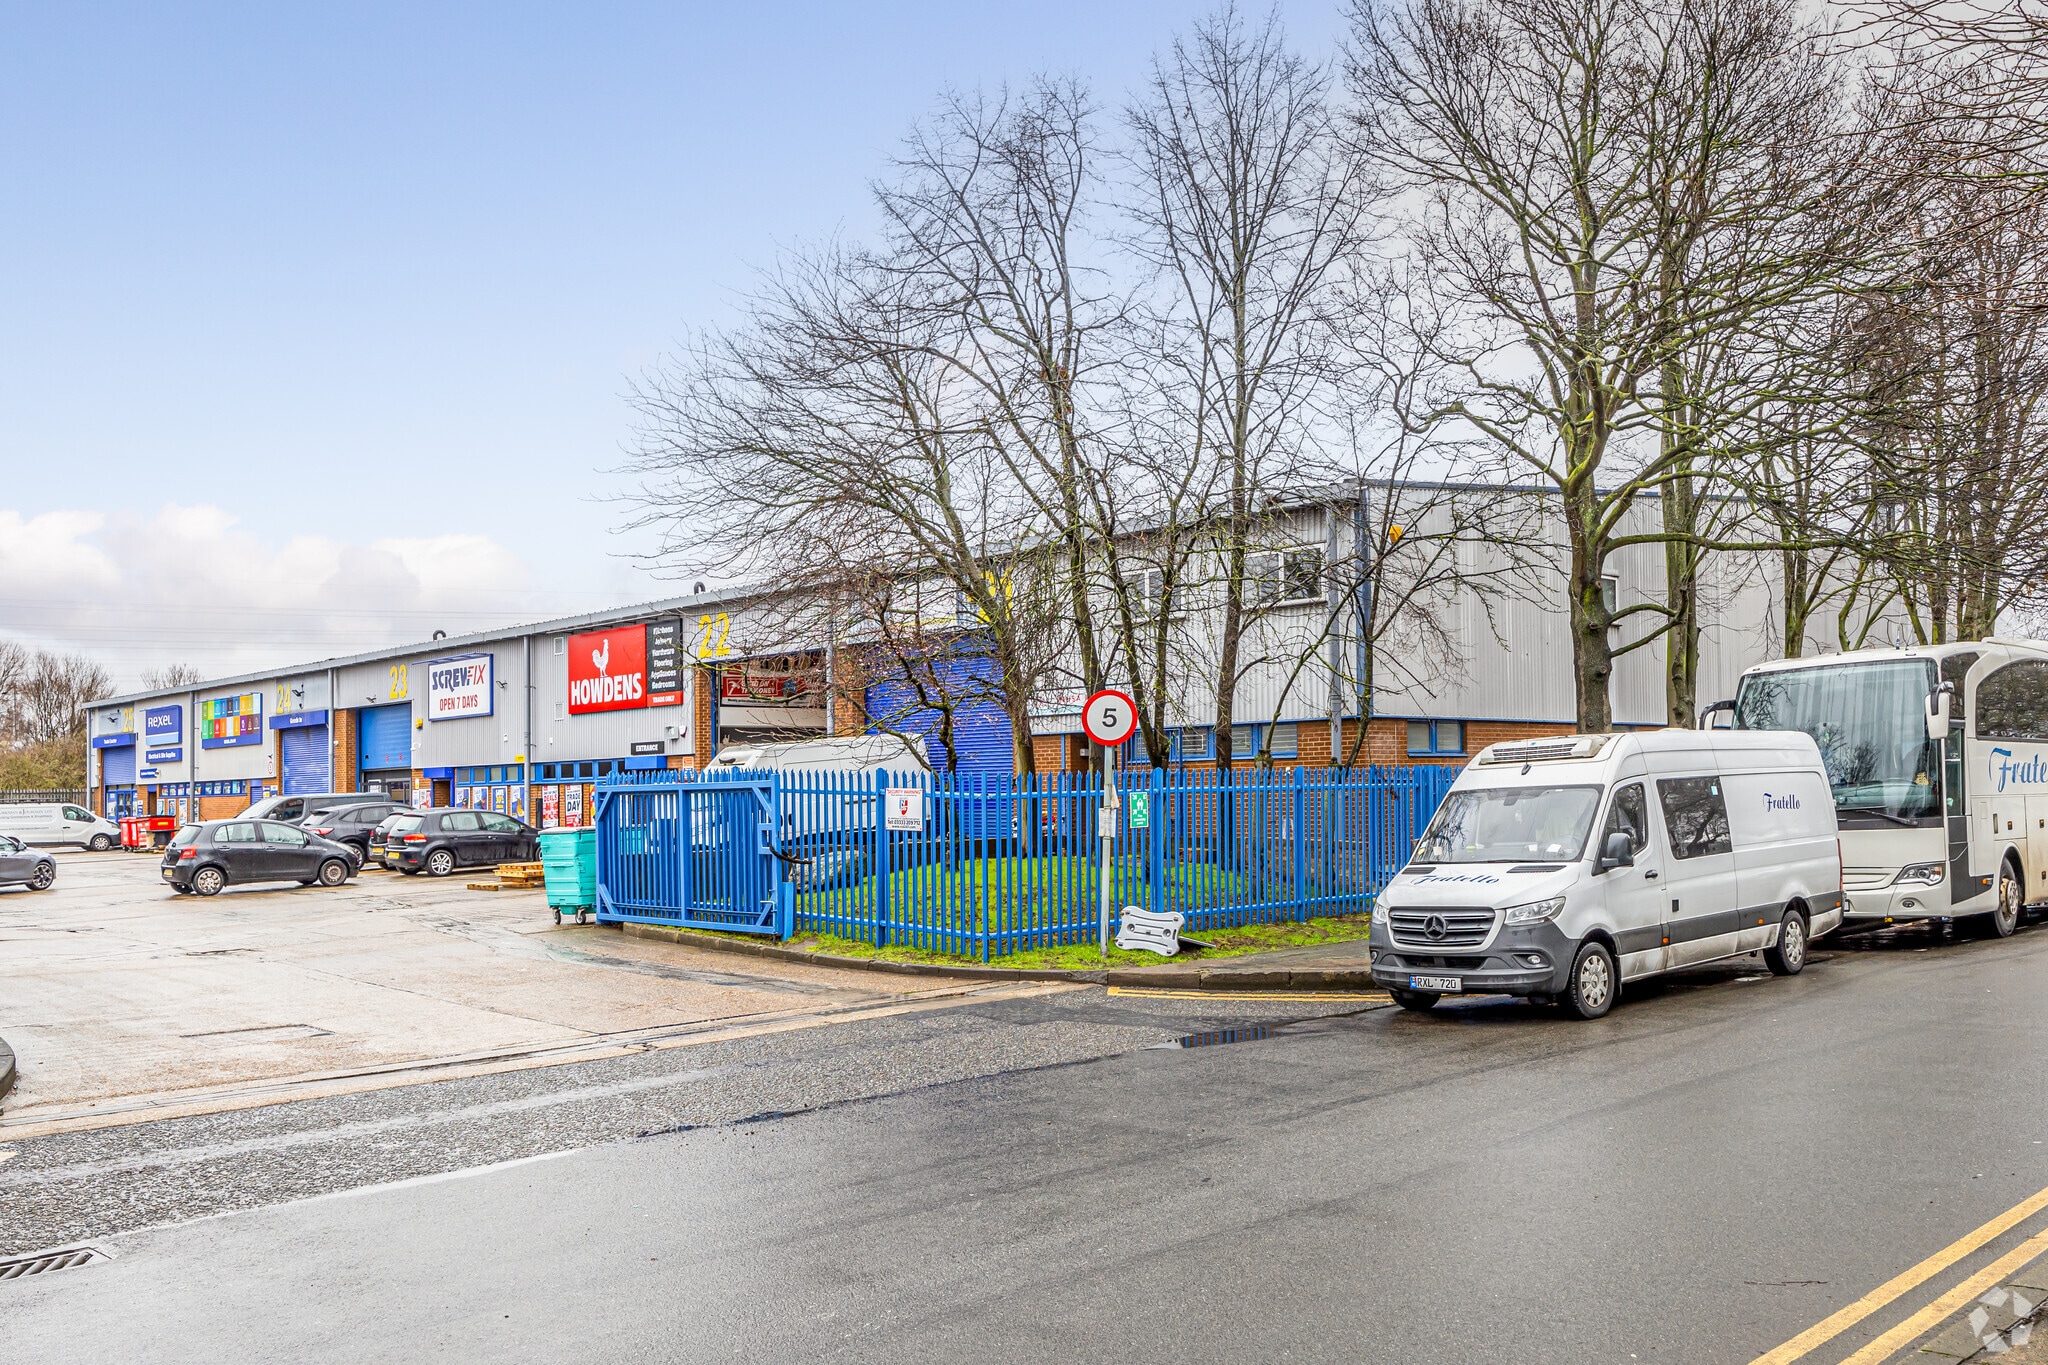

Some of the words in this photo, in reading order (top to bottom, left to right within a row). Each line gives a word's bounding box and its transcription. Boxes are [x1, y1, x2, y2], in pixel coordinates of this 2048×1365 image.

[698, 612, 730, 658] 22
[652, 648, 675, 657] Hardware
[654, 659, 673, 668] Flooring
[389, 663, 408, 699] 23
[432, 664, 486, 692] SCREWFIX
[651, 670, 677, 679] Appliances
[571, 672, 643, 706] HOWDENS
[652, 681, 676, 690] Bedrooms
[276, 683, 292, 714] 24
[440, 697, 455, 711] OPEN
[456, 697, 460, 709] 7
[462, 694, 479, 709] DAYS
[124, 707, 134, 732] 25
[1102, 708, 1118, 728] 5
[635, 744, 659, 752] ENTRANCE
[544, 794, 557, 802] DEALS
[1763, 792, 1801, 812] Fratello
[567, 800, 580, 812] DAY
[1411, 875, 1500, 885] Fratello
[1417, 977, 1434, 988] RXL
[1440, 978, 1457, 989] 720
